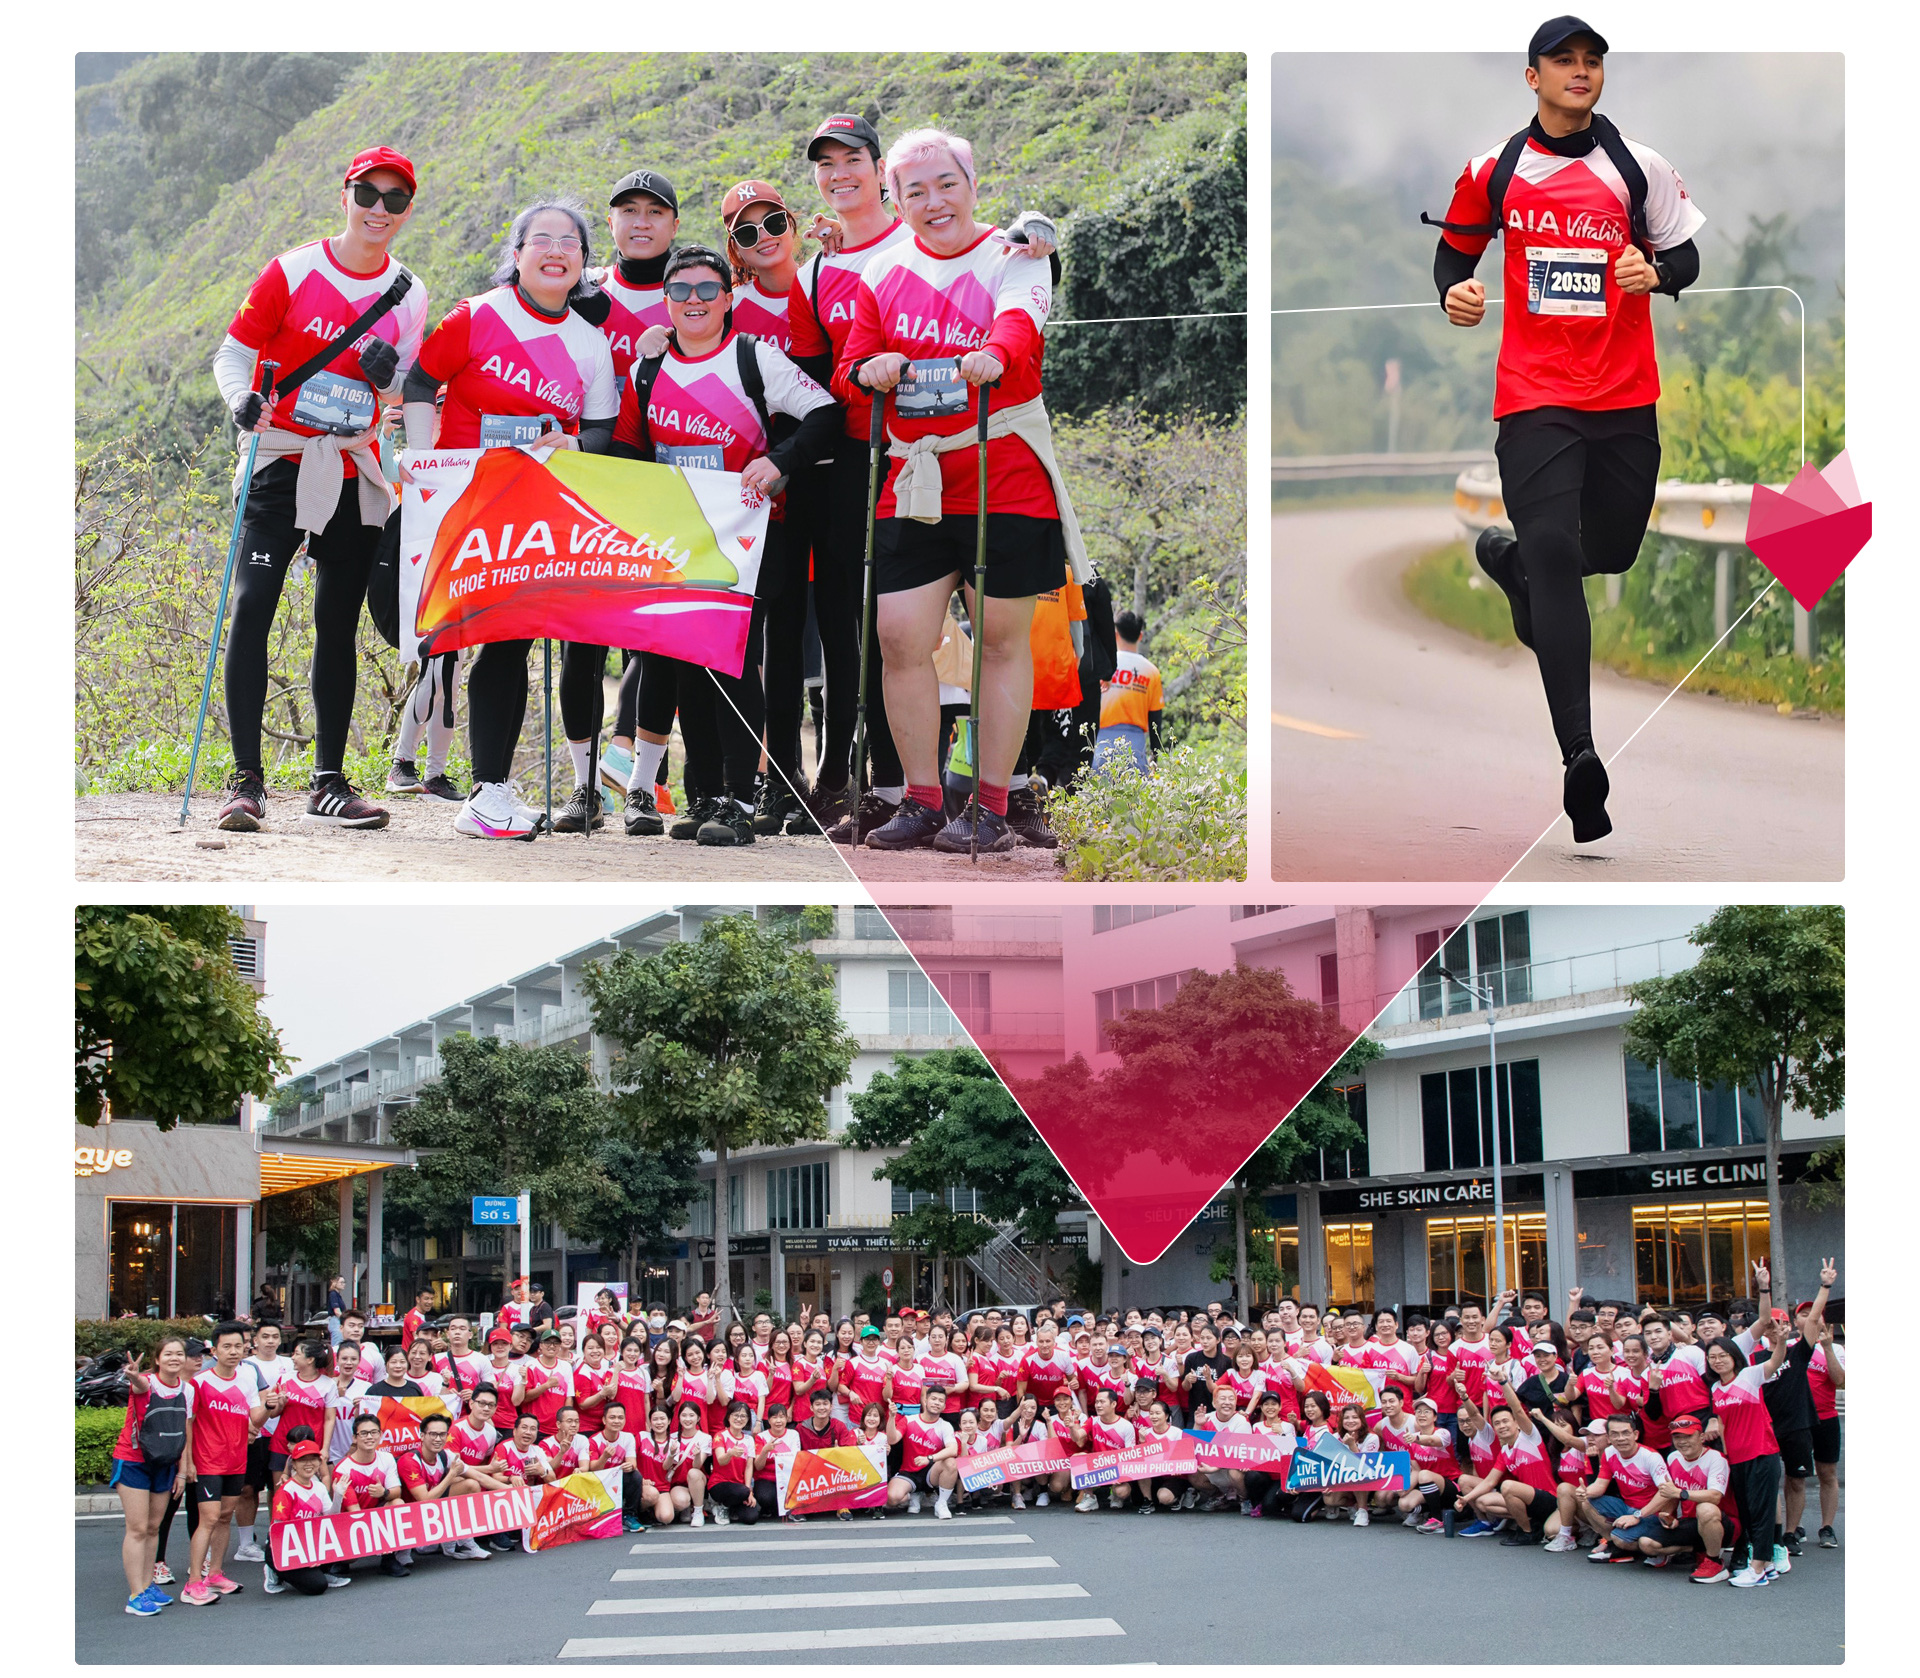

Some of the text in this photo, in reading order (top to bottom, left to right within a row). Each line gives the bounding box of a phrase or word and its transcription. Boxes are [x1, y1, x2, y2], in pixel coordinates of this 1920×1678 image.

[358, 160, 373, 168] AIA
[632, 172, 652, 188] NY
[737, 184, 757, 201] NY
[1508, 208, 1625, 247] AIA Vitality
[1551, 271, 1601, 294] 20339
[894, 313, 991, 350] AIA Vitalit
[608, 331, 631, 356] IA
[916, 367, 957, 384] M1071
[330, 384, 374, 406] M10517
[480, 355, 580, 420] AIA Vitality
[303, 391, 328, 405] 10 KM
[646, 404, 737, 448] AIA Vitality
[484, 439, 493, 447] 10
[411, 457, 470, 470] AIA Vitality
[676, 455, 718, 469] F10714
[740, 500, 760, 509] AIA
[450, 512, 691, 573] AIA Vitality
[491, 564, 529, 586] THEO
[534, 559, 574, 578] CÁCH
[580, 557, 613, 578] CỦA
[617, 562, 653, 581] BẠN
[75, 1147, 133, 1173] aye
[1651, 1168, 1697, 1188] SHE
[1359, 1183, 1493, 1207] SHE SKIN CARE
[480, 1208, 510, 1220] SỐ 5
[1145, 1206, 1172, 1223] SIÊU
[1202, 1205, 1228, 1219] SHE
[828, 1236, 889, 1246] TƯ VẤN THIẾT
[1433, 1364, 1446, 1372] AIA
[1462, 1359, 1477, 1367] AIA
[620, 1380, 633, 1388] AIA
[860, 1373, 873, 1381] AIA
[1672, 1373, 1694, 1384] Vitality
[286, 1391, 300, 1402] AIA
[1587, 1384, 1602, 1393] AIA
[1337, 1390, 1368, 1405] Vitality
[209, 1400, 229, 1413] AIA
[379, 1426, 414, 1445] AIA
[909, 1433, 923, 1444] AIA
[1094, 1434, 1107, 1443] AIA
[461, 1446, 476, 1458] AIA
[971, 1446, 1016, 1470] HEALTHIER
[1092, 1453, 1117, 1469] SỐNG
[1143, 1442, 1164, 1457] HƠN
[1194, 1442, 1254, 1463] AIA VIỆT
[1008, 1457, 1071, 1475] BETTER LIVES
[1149, 1459, 1174, 1473] PHÚC
[1175, 1459, 1196, 1472] HƠN
[1296, 1463, 1317, 1477] LIVE
[1320, 1452, 1394, 1489] Vitality
[796, 1468, 867, 1494] AIA Vitality
[966, 1467, 1003, 1490] LONGER
[1078, 1468, 1117, 1488] LÂU HƠN
[1300, 1476, 1318, 1486] WITH
[1612, 1471, 1627, 1483] AIA
[1674, 1477, 1689, 1489] AIA
[537, 1496, 601, 1531] AIA Vitality
[281, 1518, 344, 1567] AIA
